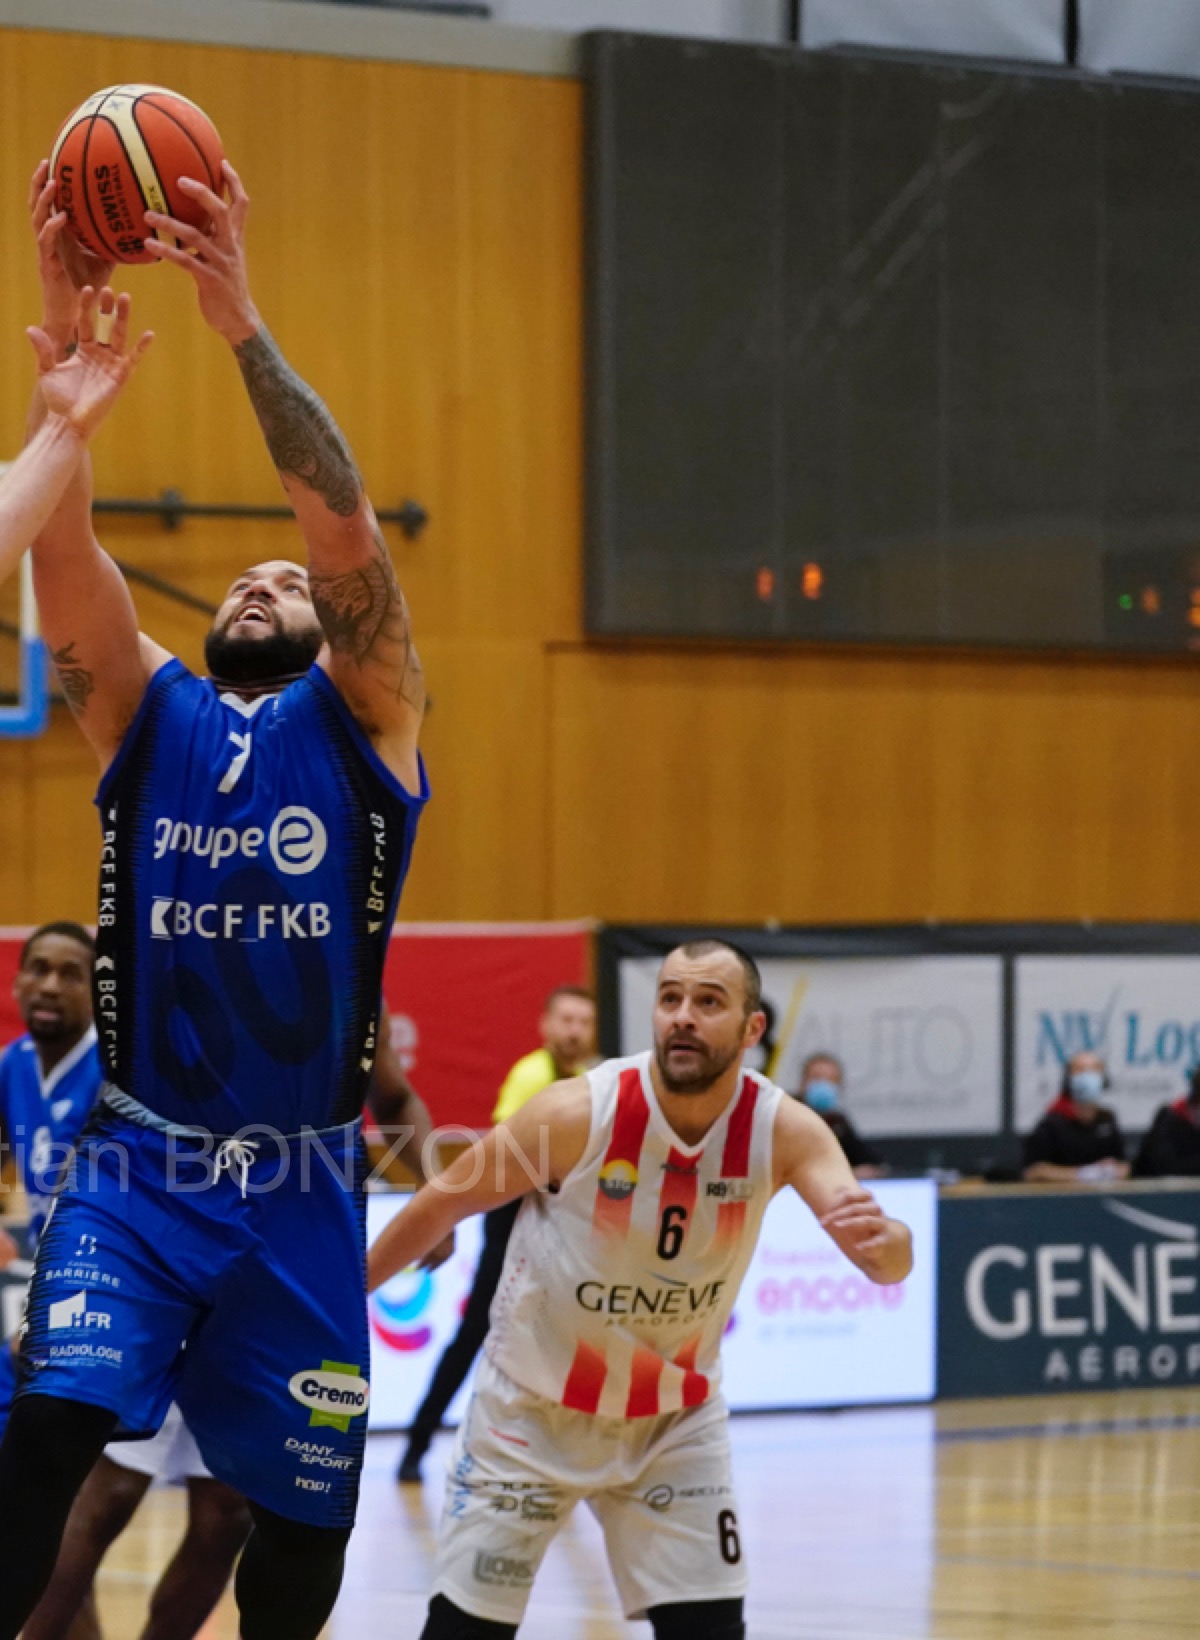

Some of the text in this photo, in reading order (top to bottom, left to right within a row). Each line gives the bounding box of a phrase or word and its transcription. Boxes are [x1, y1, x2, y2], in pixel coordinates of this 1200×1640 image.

[656, 1204, 688, 1261] 6
[301, 1377, 365, 1407] Cremo
[284, 1437, 335, 1456] DANY
[300, 1453, 355, 1471] SPORT
[717, 1507, 742, 1566] 6
